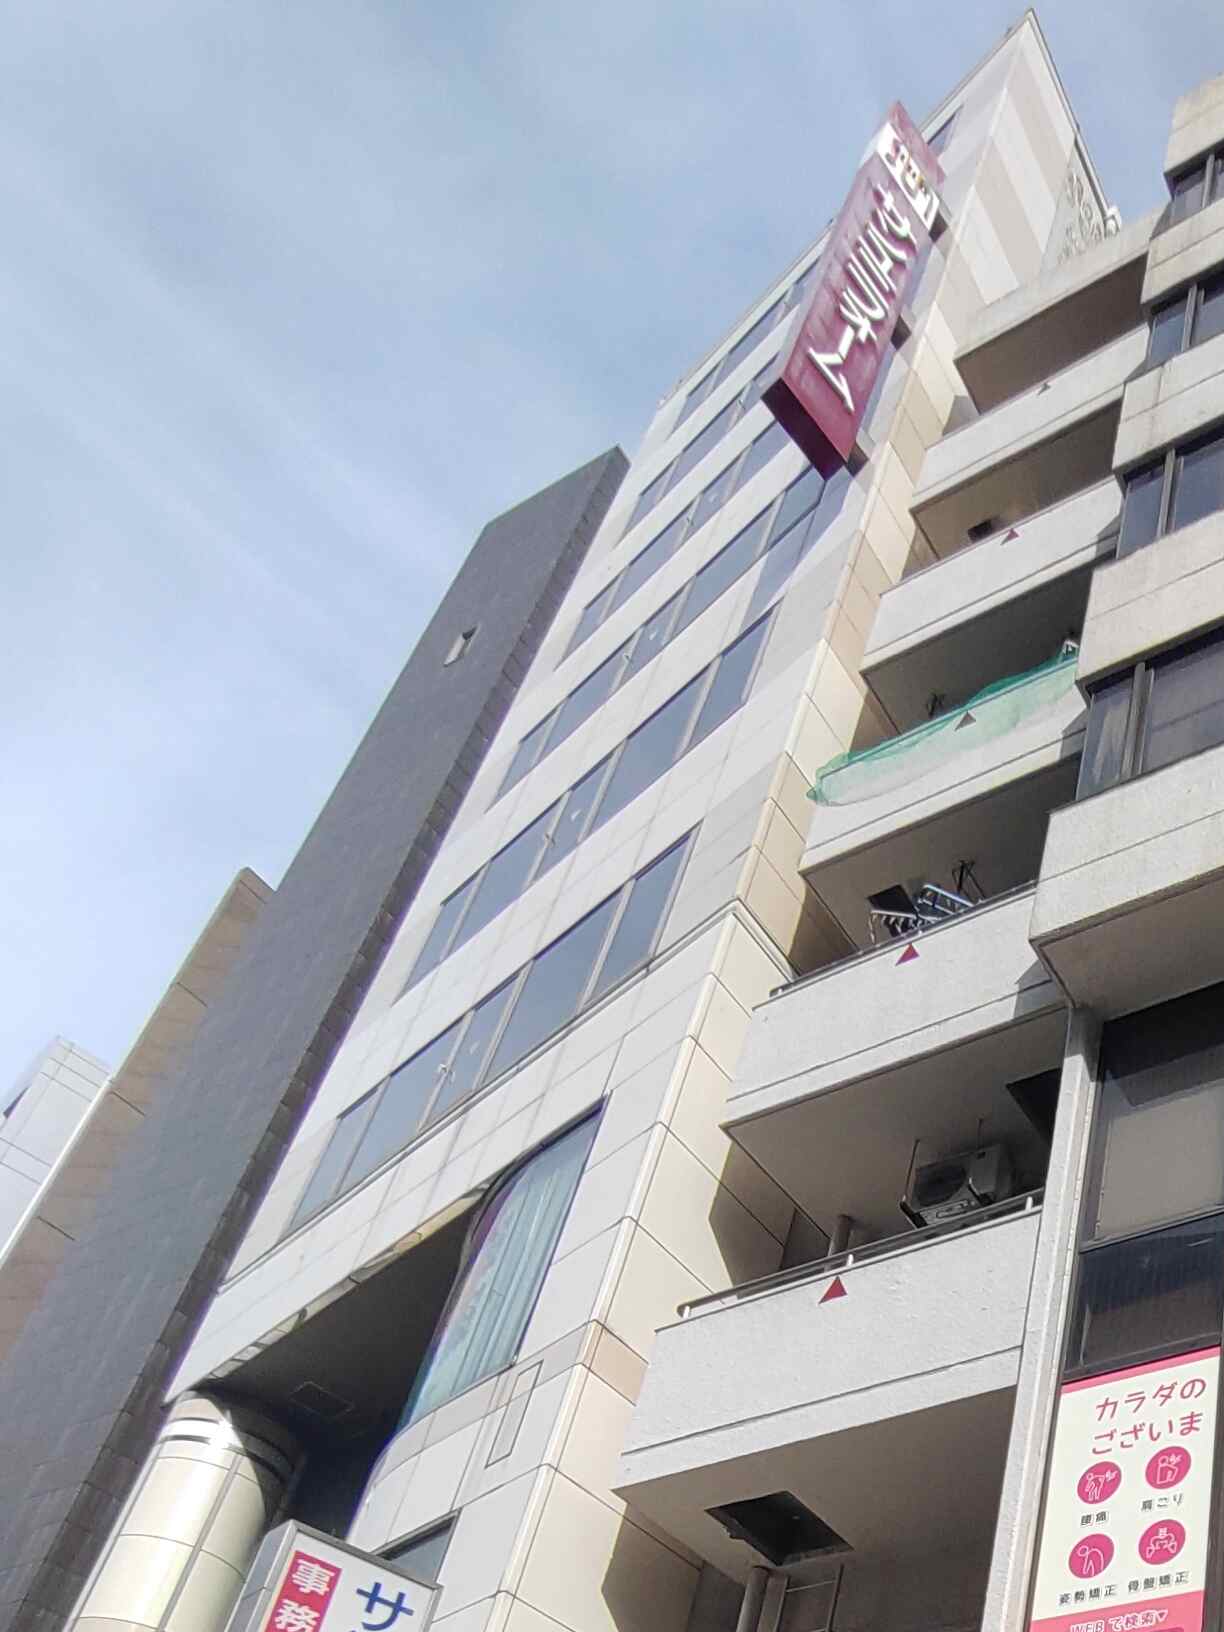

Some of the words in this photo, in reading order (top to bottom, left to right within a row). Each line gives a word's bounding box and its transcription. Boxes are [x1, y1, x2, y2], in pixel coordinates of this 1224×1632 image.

[1096, 1378, 1206, 1422] カラダの
[1092, 1411, 1203, 1455] ございま
